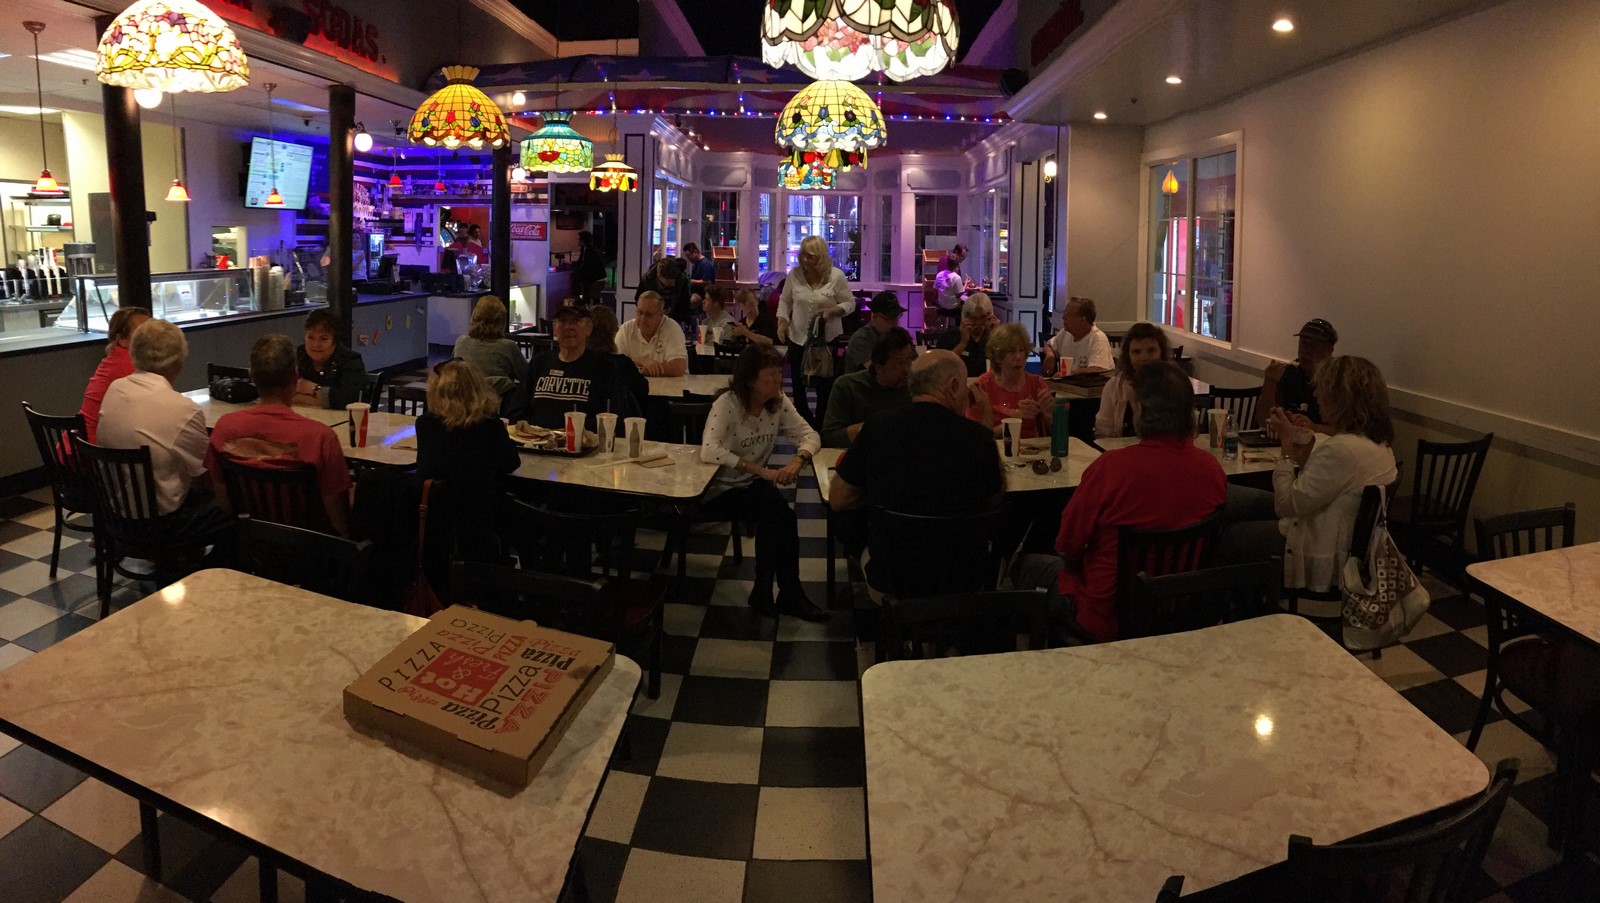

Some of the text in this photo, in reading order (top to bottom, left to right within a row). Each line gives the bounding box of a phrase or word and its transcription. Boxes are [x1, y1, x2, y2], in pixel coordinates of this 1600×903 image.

[535, 376, 592, 396] CORVETTE
[436, 629, 499, 655] Pizza
[450, 618, 507, 644] Pizza
[492, 635, 528, 661] PIZZA
[520, 648, 576, 670] Pizza
[378, 640, 446, 692] PIZZA
[448, 652, 507, 681] Fresh
[420, 671, 484, 702] Hot
[479, 664, 542, 715] Pizza
[441, 700, 500, 731] Pizza
[494, 669, 564, 734] PIZZA
